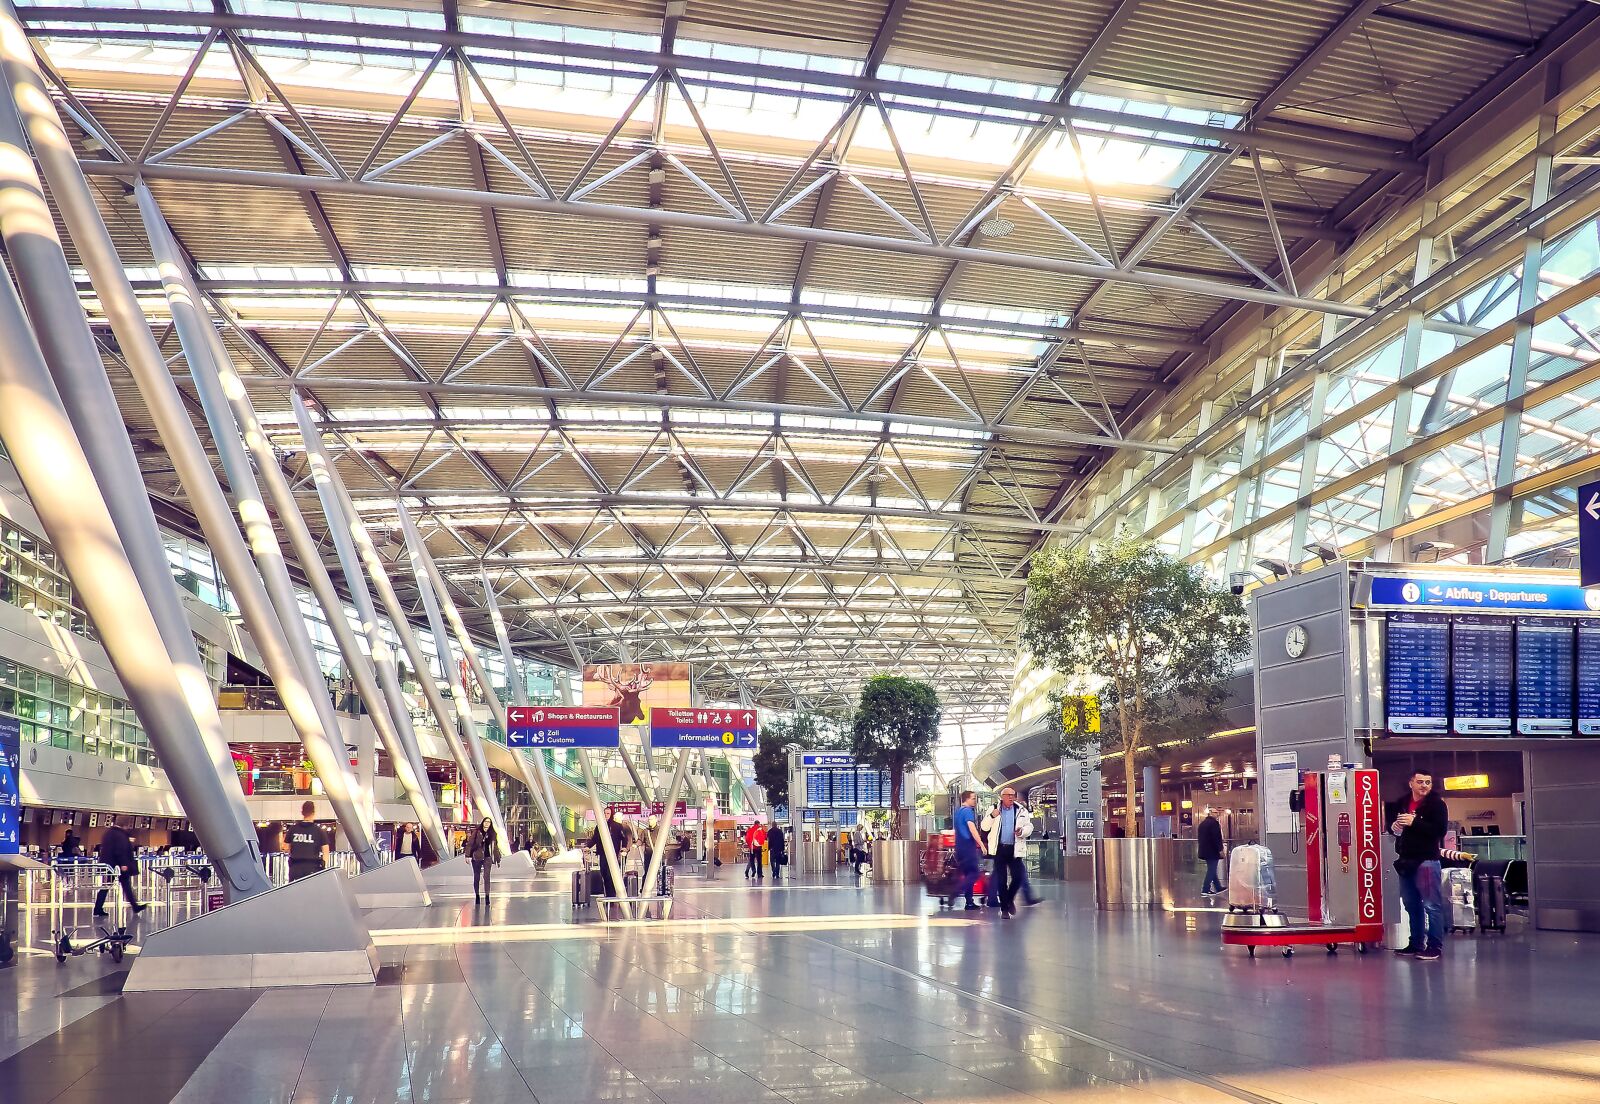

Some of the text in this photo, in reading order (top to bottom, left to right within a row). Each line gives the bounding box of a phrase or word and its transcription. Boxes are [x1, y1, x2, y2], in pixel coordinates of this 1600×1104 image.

[1445, 587, 1483, 603] Abflug
[1489, 588, 1548, 604] Departures
[678, 733, 720, 742] Information
[292, 833, 314, 843] ZOLL
[1361, 775, 1375, 918] SAFER BAG
